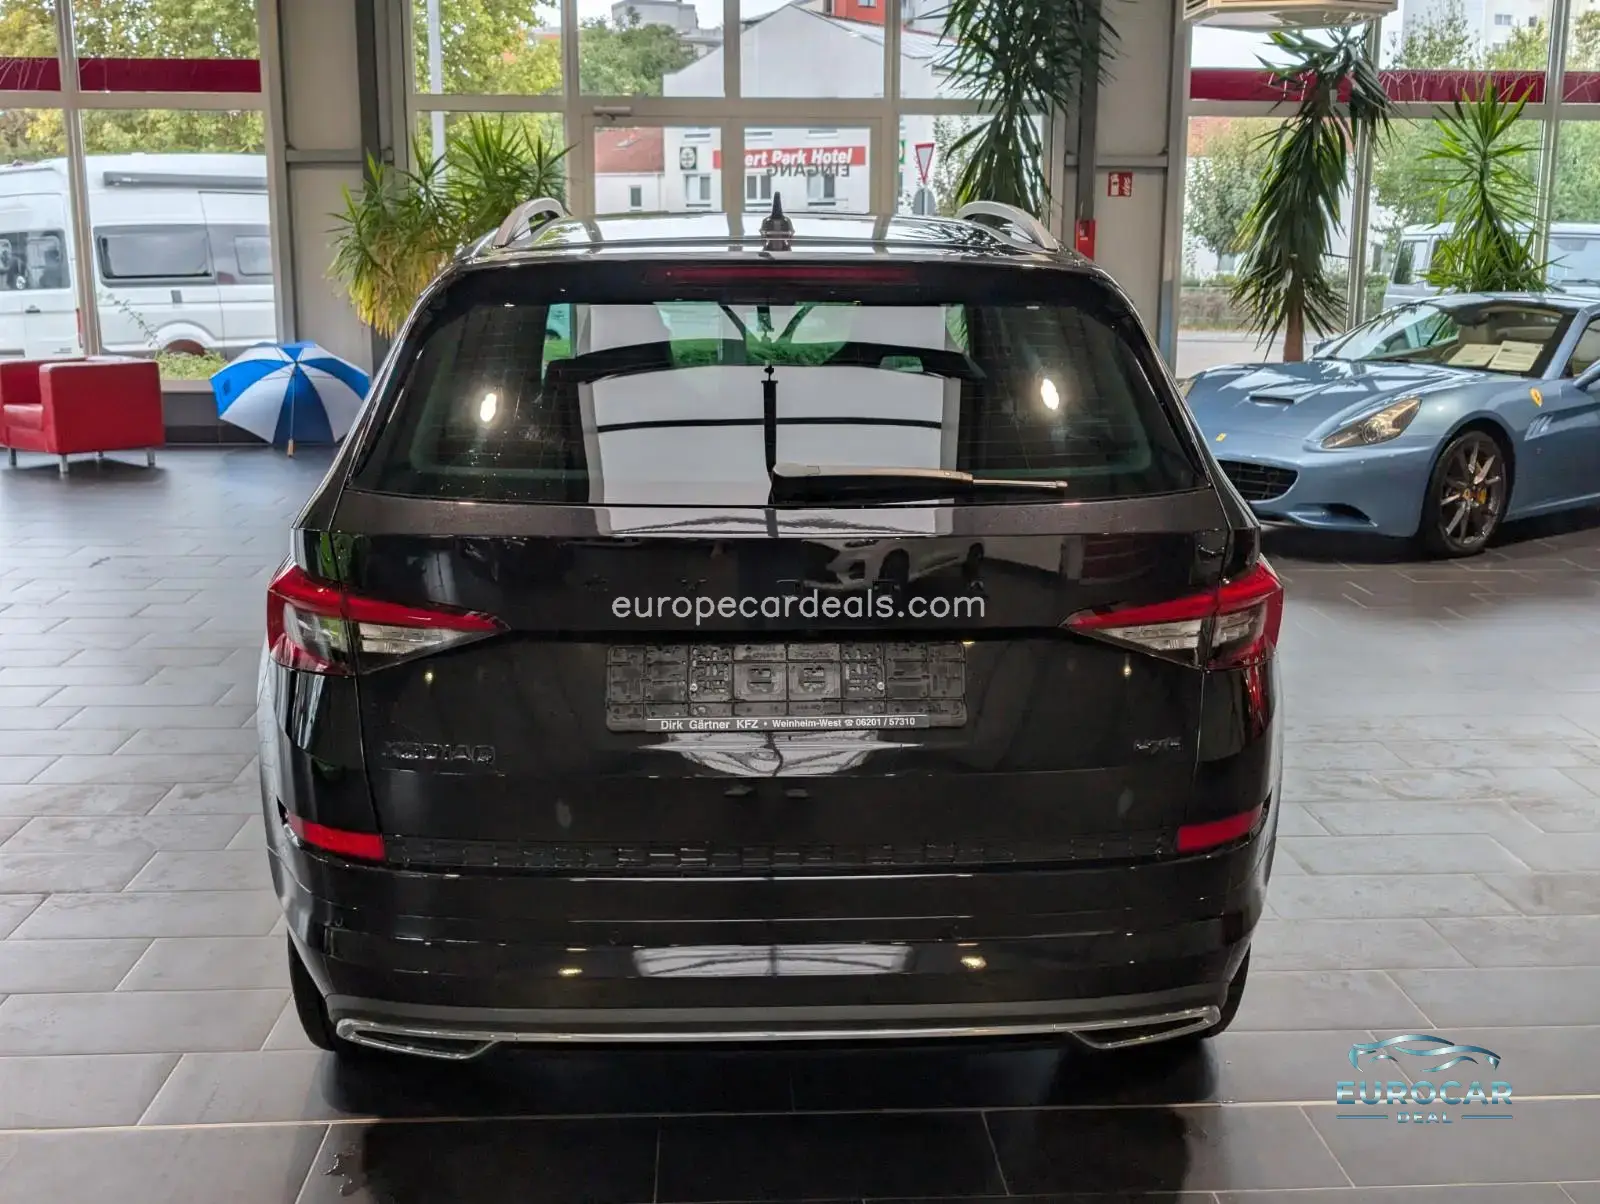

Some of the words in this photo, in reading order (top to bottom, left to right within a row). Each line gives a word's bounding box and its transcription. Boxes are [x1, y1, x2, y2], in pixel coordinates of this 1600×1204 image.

[771, 149, 807, 165] Park
[811, 147, 853, 164] Hotel
[660, 719, 684, 731] Dirk
[688, 719, 731, 730] Gärtner
[736, 719, 759, 730] KFZ
[771, 718, 842, 728] Weinheim-West
[855, 718, 881, 726] 06201
[888, 717, 916, 726] 57310
